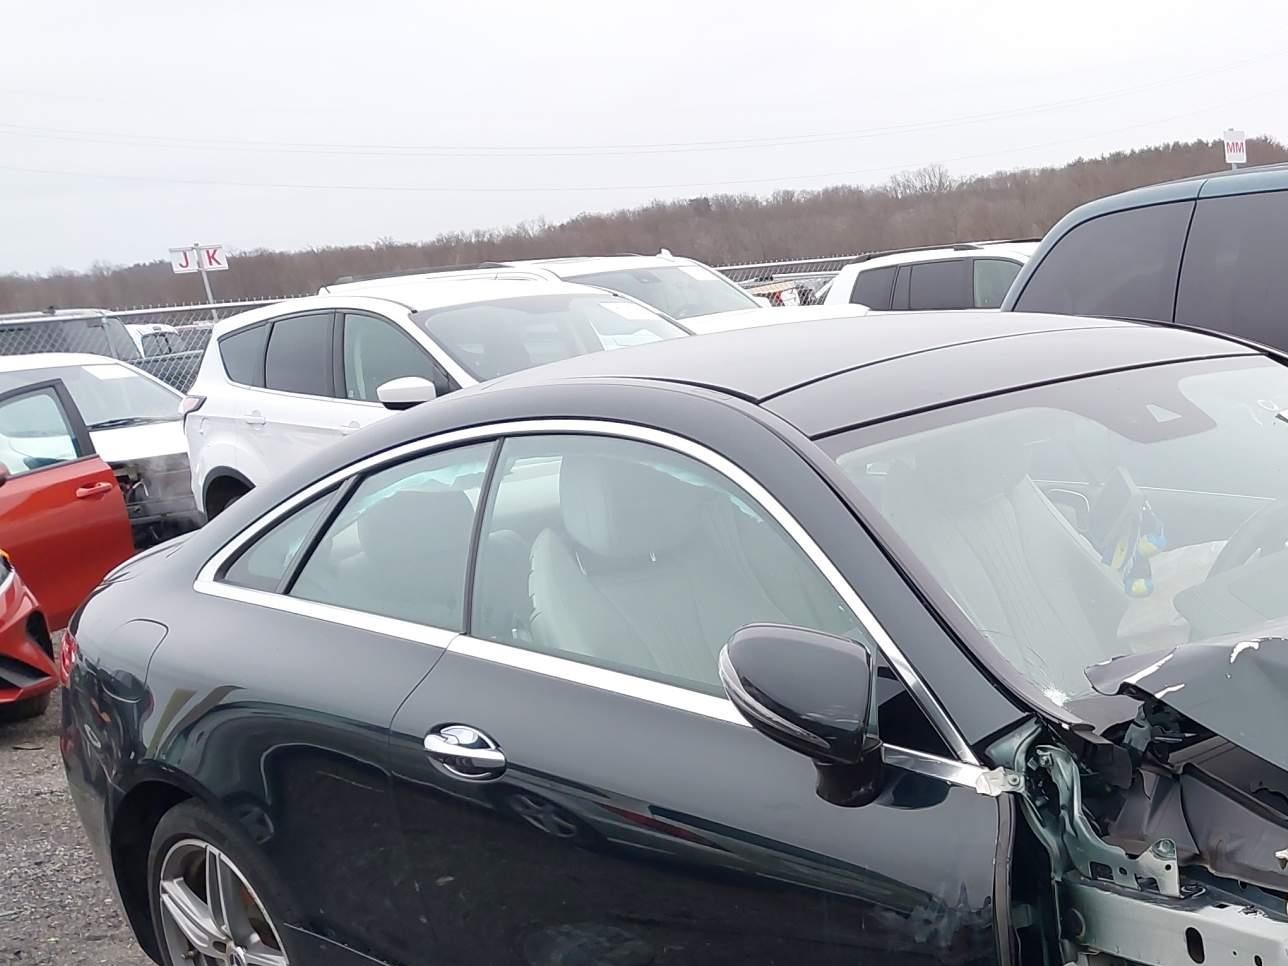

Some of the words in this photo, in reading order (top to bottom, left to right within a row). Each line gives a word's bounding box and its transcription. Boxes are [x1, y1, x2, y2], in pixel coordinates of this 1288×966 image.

[1226, 141, 1245, 153] MM
[179, 250, 189, 268] J
[206, 249, 222, 266] K
